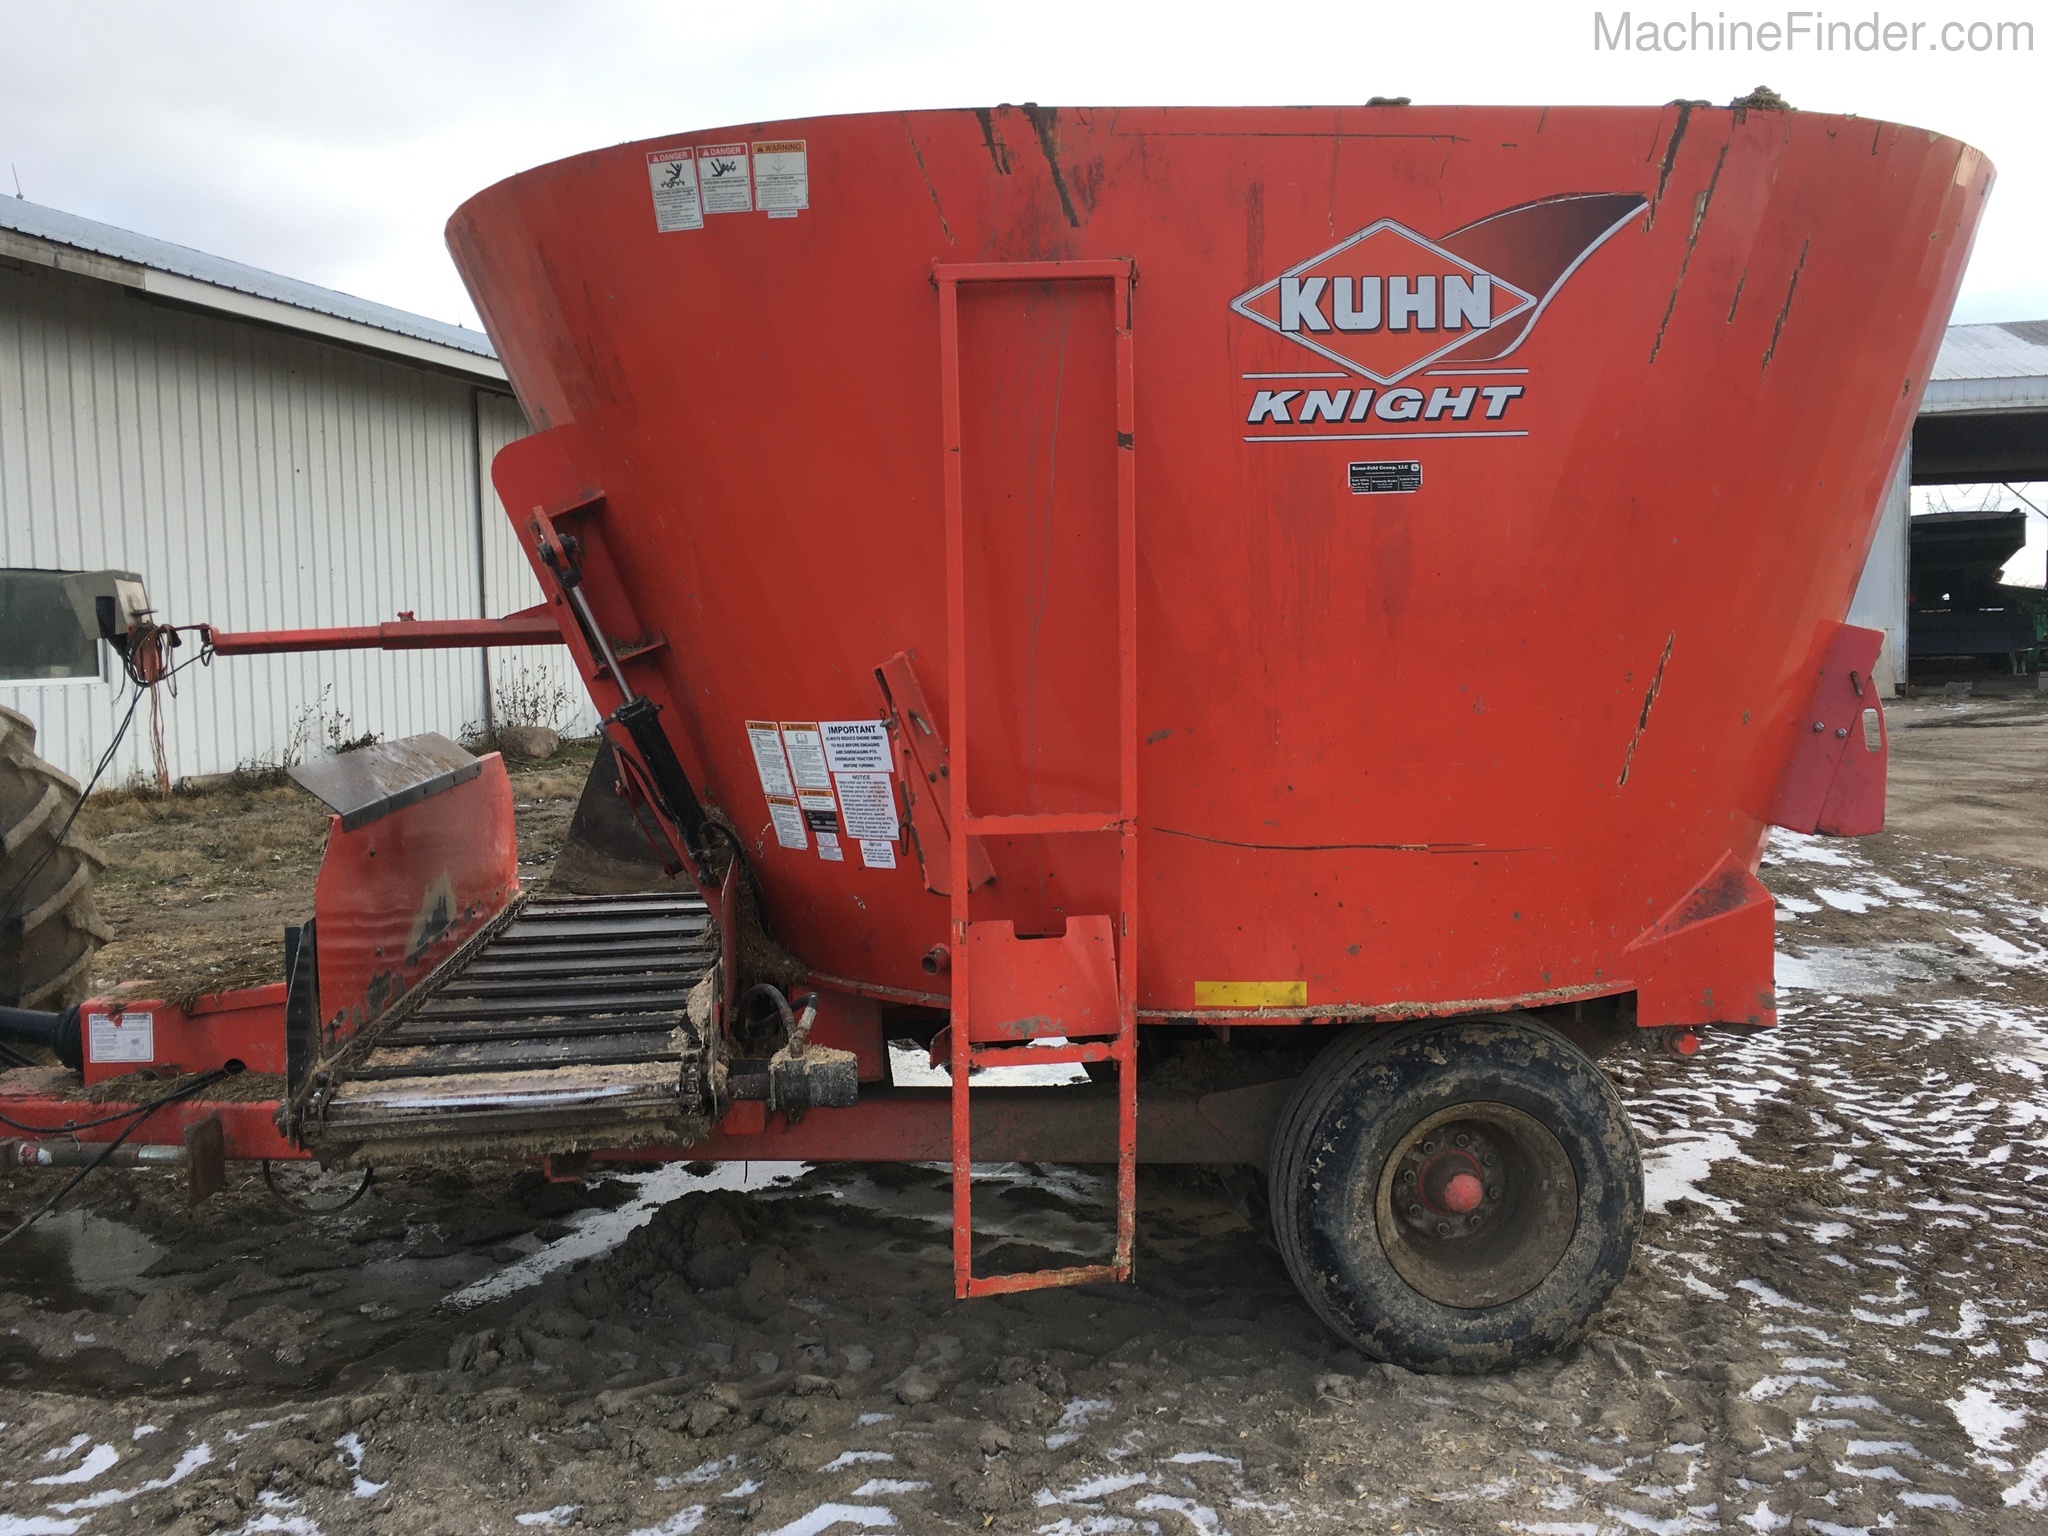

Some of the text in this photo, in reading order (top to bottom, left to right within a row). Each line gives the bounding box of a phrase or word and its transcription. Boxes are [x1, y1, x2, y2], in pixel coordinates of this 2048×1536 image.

[710, 147, 741, 156] DANGER
[765, 144, 801, 152] WARNING
[660, 152, 688, 162] DANGER
[1280, 274, 1492, 333] KUHN
[1246, 385, 1526, 425] KNIGHT
[828, 726, 876, 734] IMPORTANT
